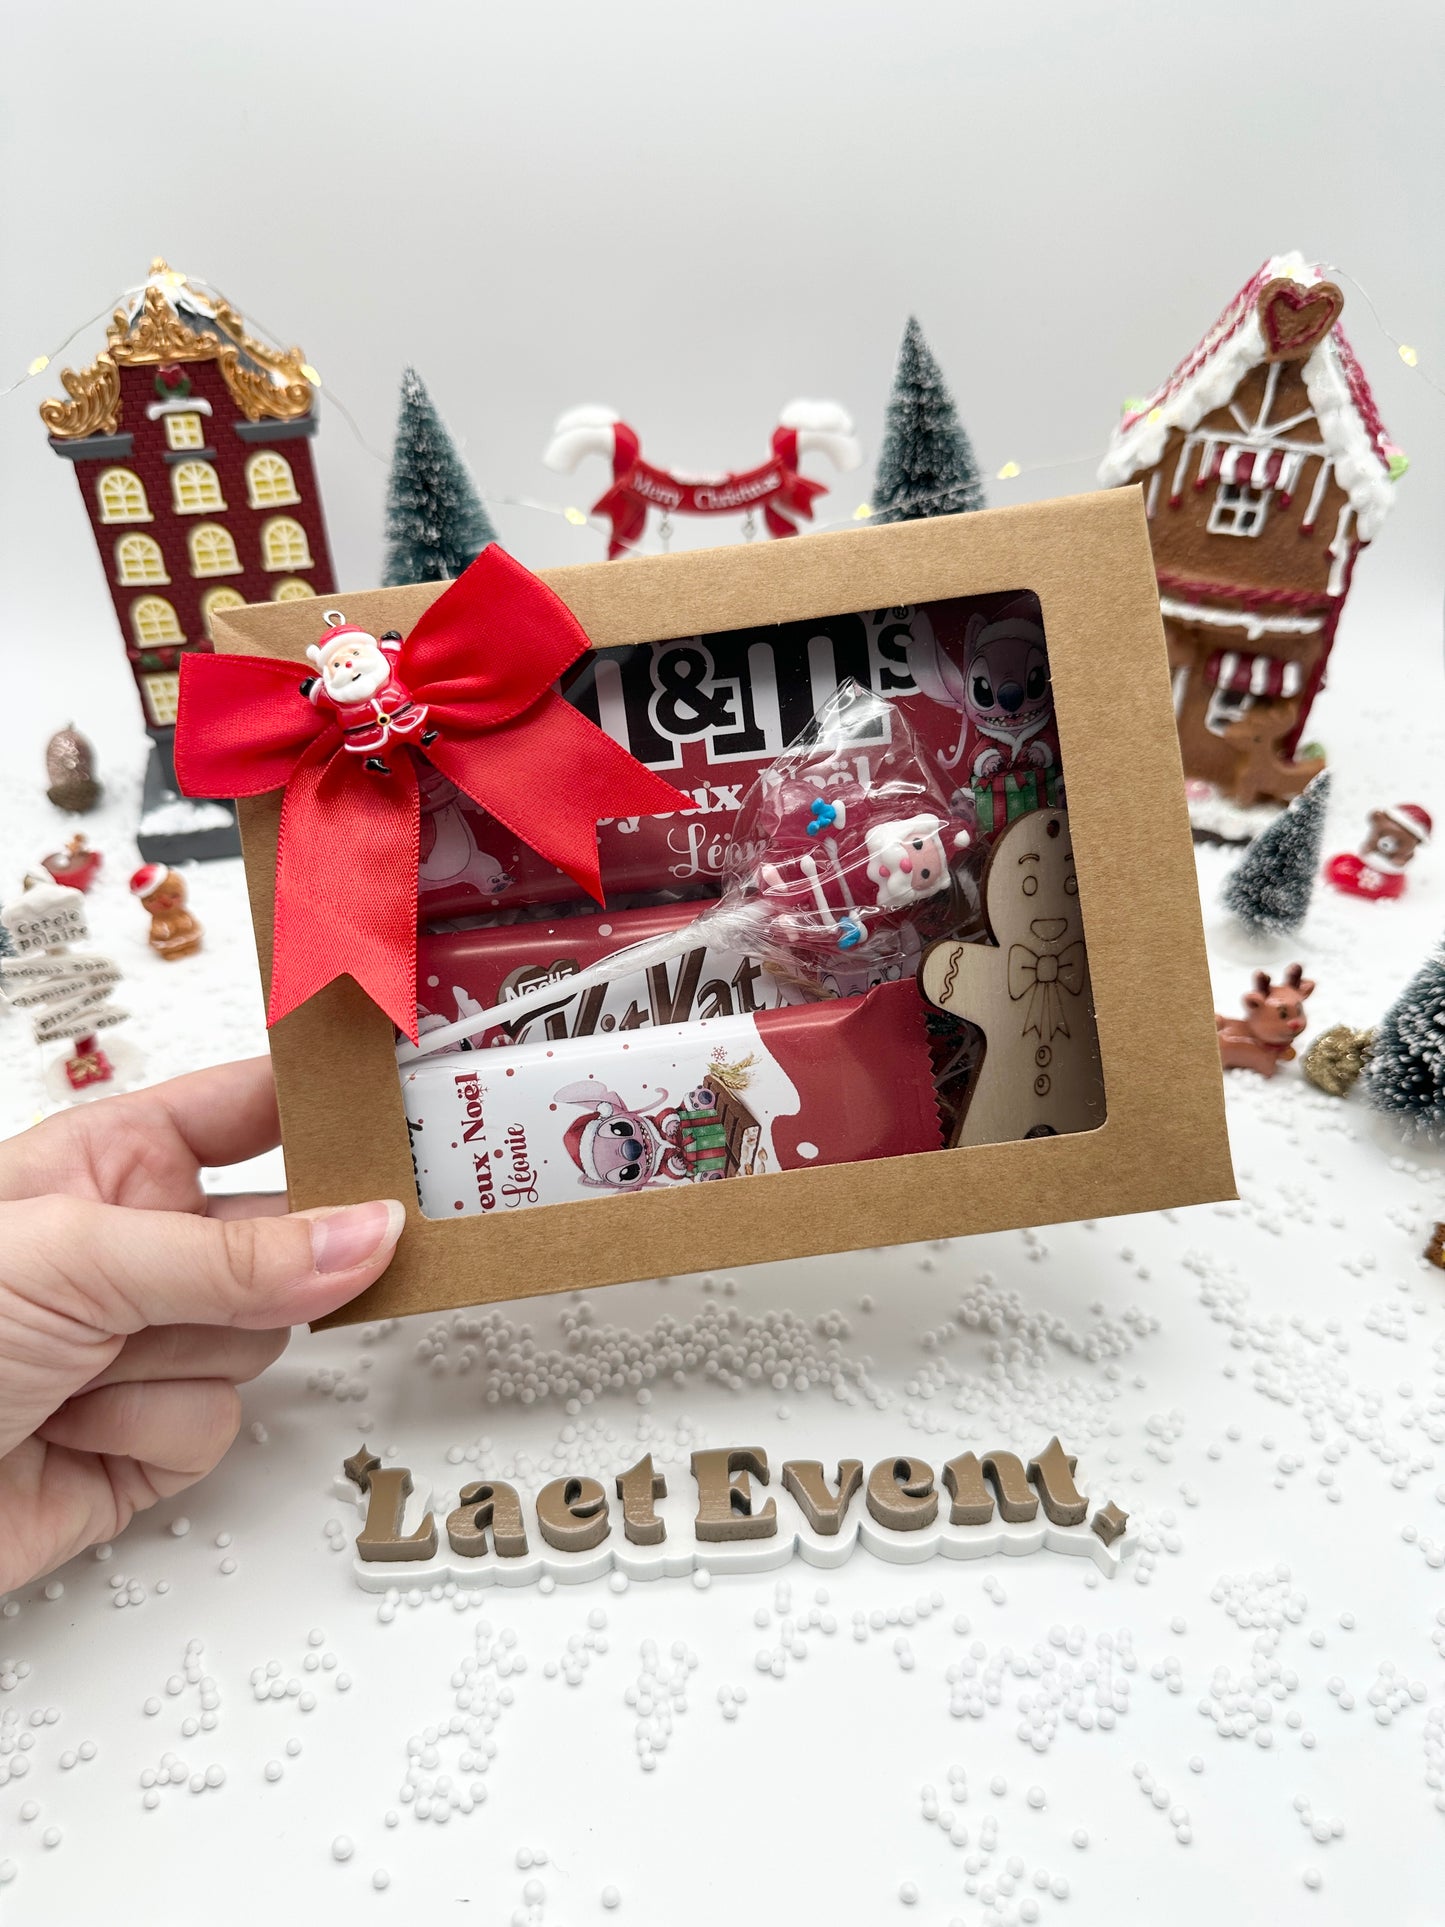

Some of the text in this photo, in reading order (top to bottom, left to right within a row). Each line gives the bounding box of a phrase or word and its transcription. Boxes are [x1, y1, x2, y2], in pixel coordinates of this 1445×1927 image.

[633, 470, 782, 511] Merry Christmas
[454, 1071, 497, 1213] eux Noël
[502, 1122, 539, 1208] Léonie
[355, 1436, 1089, 1562] Laet Event
